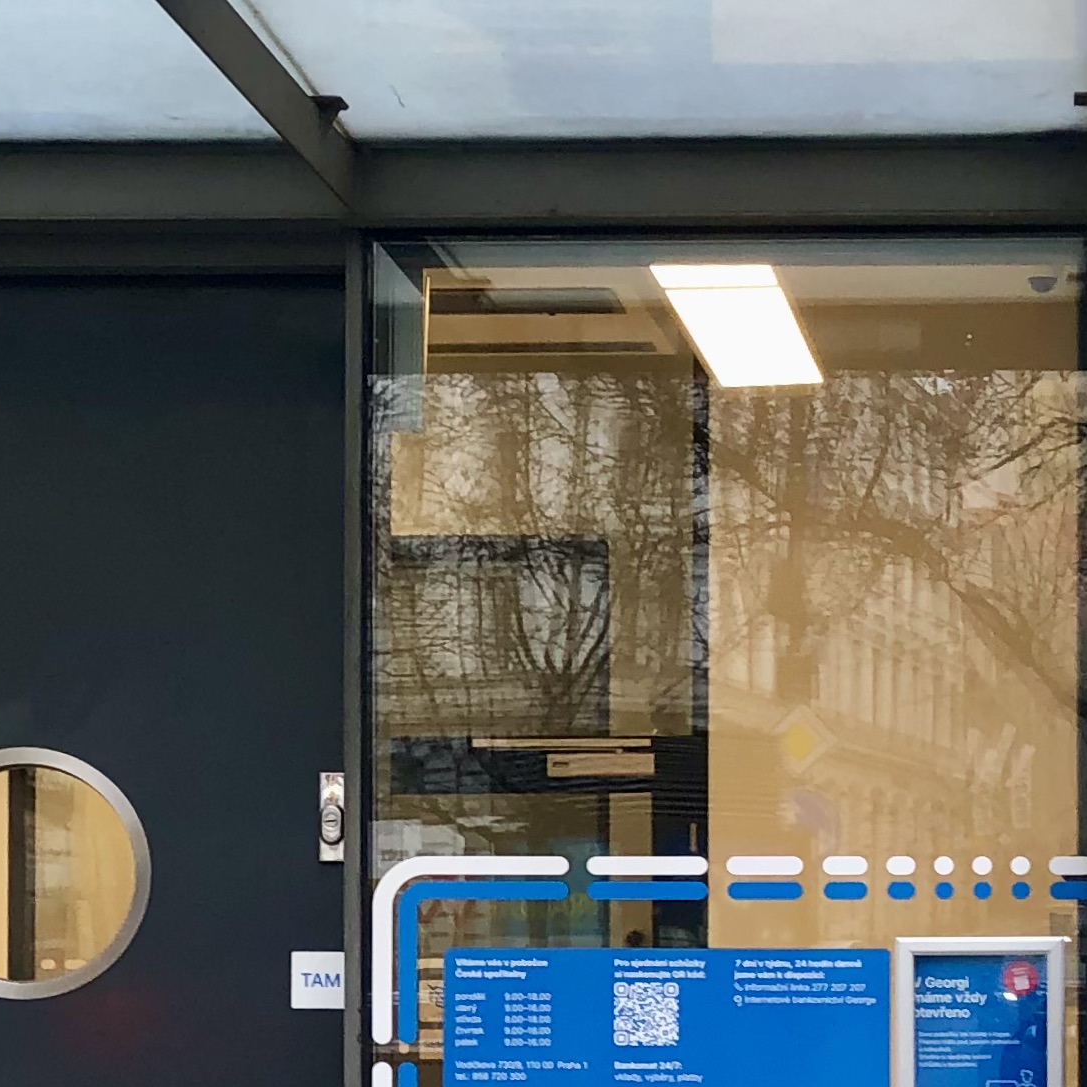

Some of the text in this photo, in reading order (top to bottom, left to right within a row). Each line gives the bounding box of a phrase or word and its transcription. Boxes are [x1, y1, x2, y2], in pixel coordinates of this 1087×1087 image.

[301, 973, 340, 987] TAM
[925, 976, 969, 992] Georgi
[955, 989, 987, 1005] vždy
[915, 1006, 971, 1018] otevřeno
